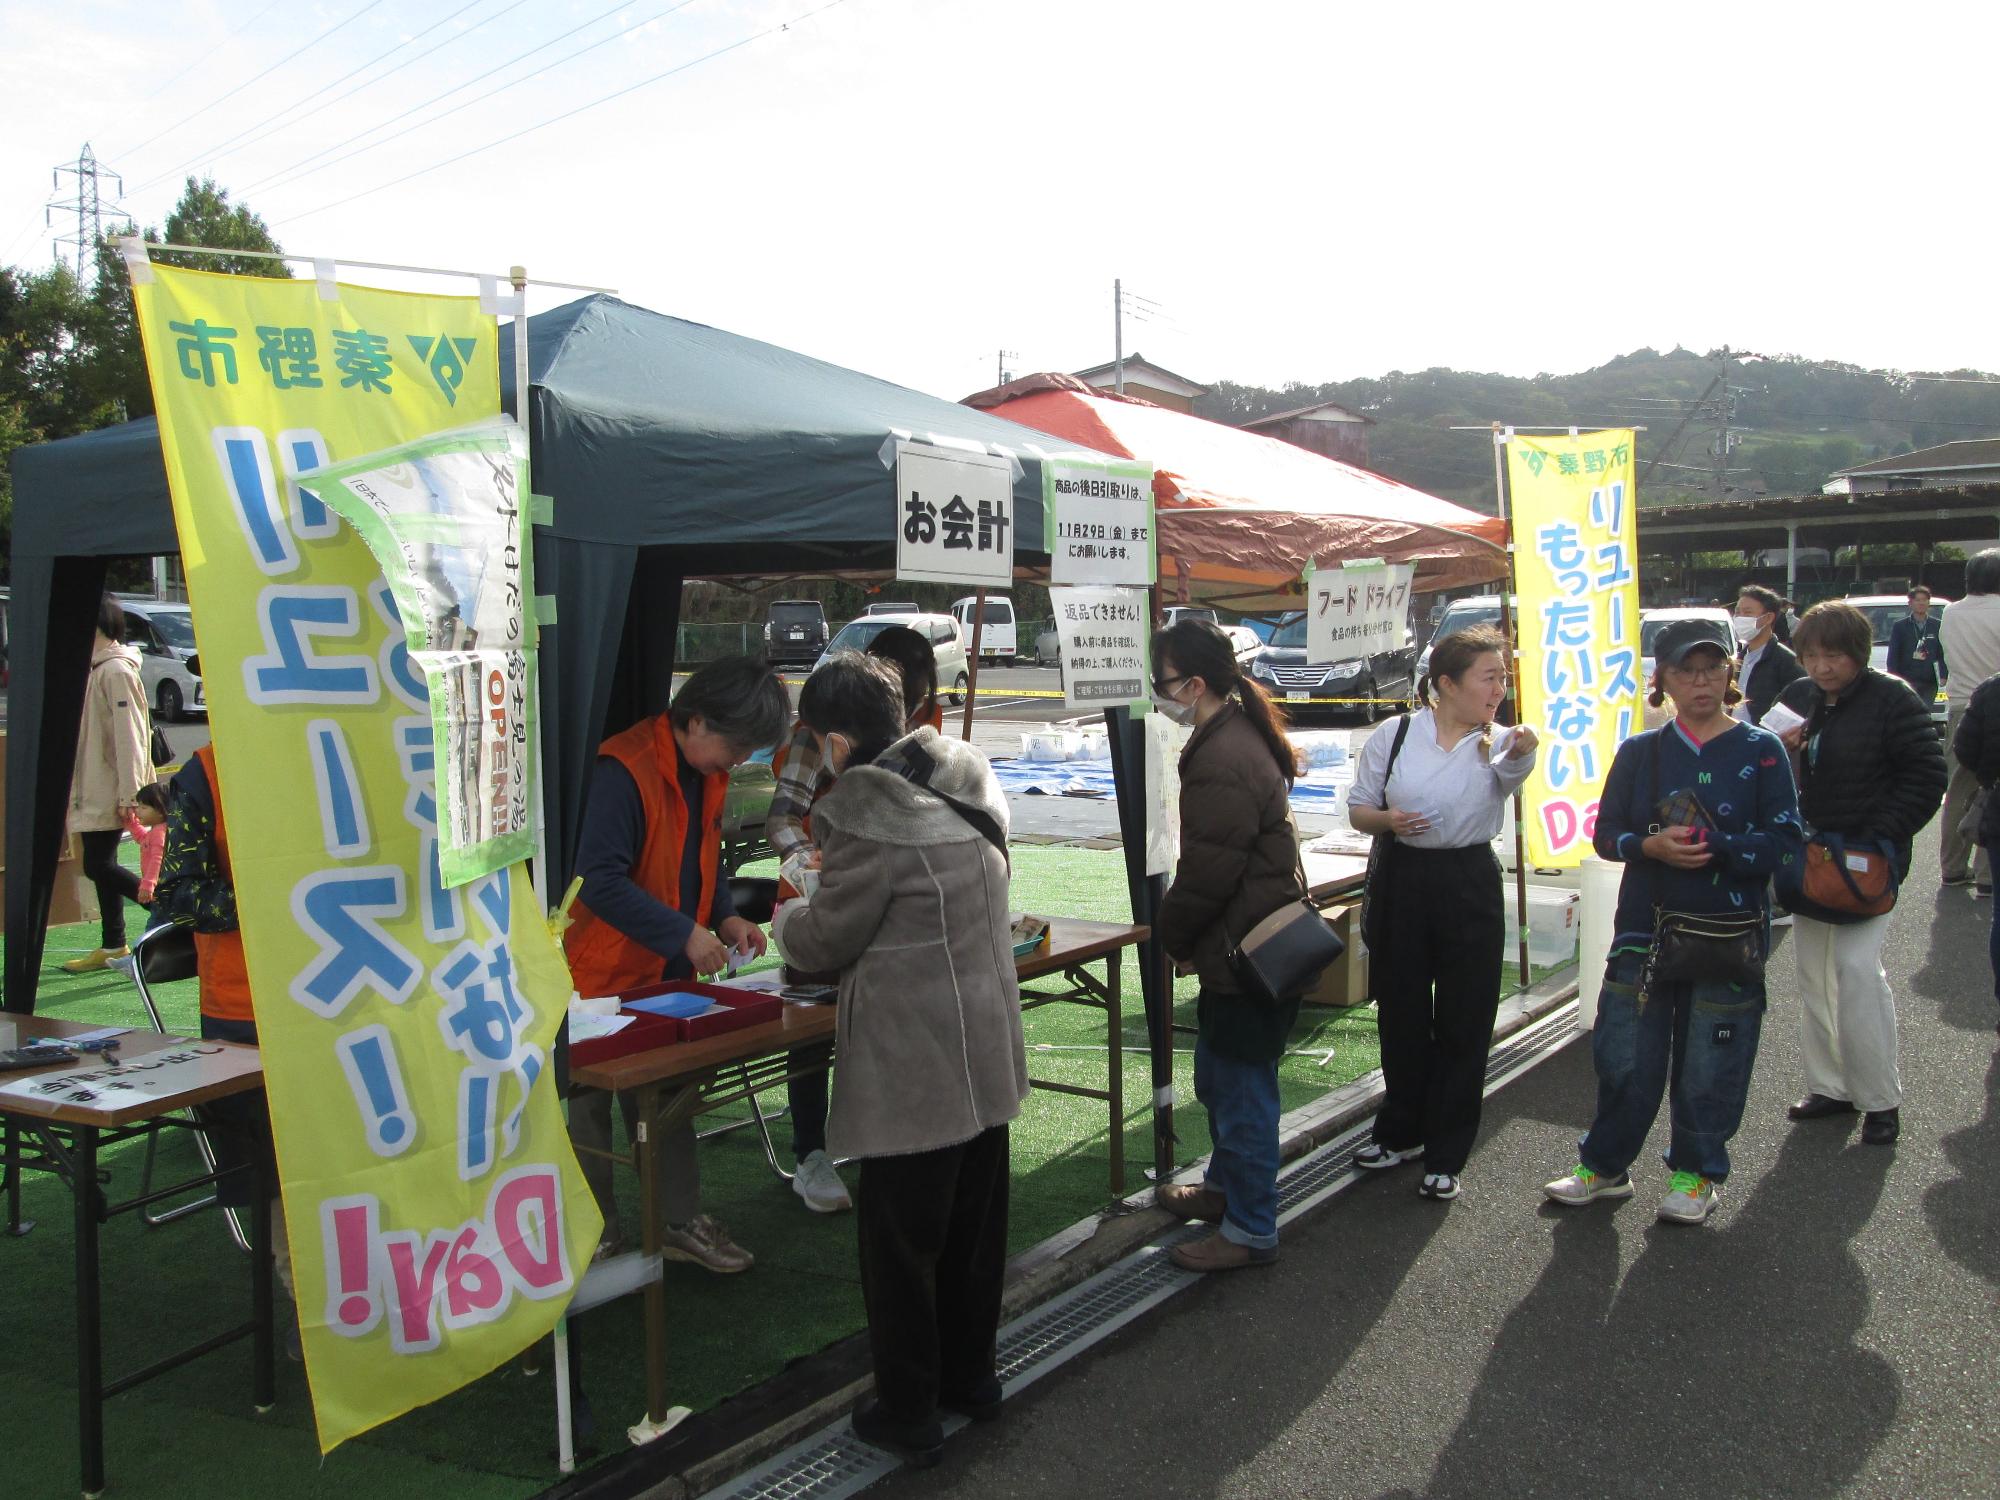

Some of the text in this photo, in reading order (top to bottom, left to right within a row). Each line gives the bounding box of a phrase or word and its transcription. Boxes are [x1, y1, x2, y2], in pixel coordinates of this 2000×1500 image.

[1558, 443, 1629, 475] 秦野市
[1055, 479, 1143, 500] 商品の後日引取りは、
[904, 490, 1010, 554] お会計
[1068, 544, 1130, 560] にお願いします。
[1318, 582, 1407, 619] フード ドライブ
[1064, 602, 1140, 621] 返品できません！
[1073, 636, 1138, 648] 購入前に商品を確認し、
[1071, 657, 1143, 669] 納得の上、ご購入ください。
[1541, 523, 1595, 788] もったいない
[1747, 730, 1761, 742] S
[1698, 772, 1712, 784] M
